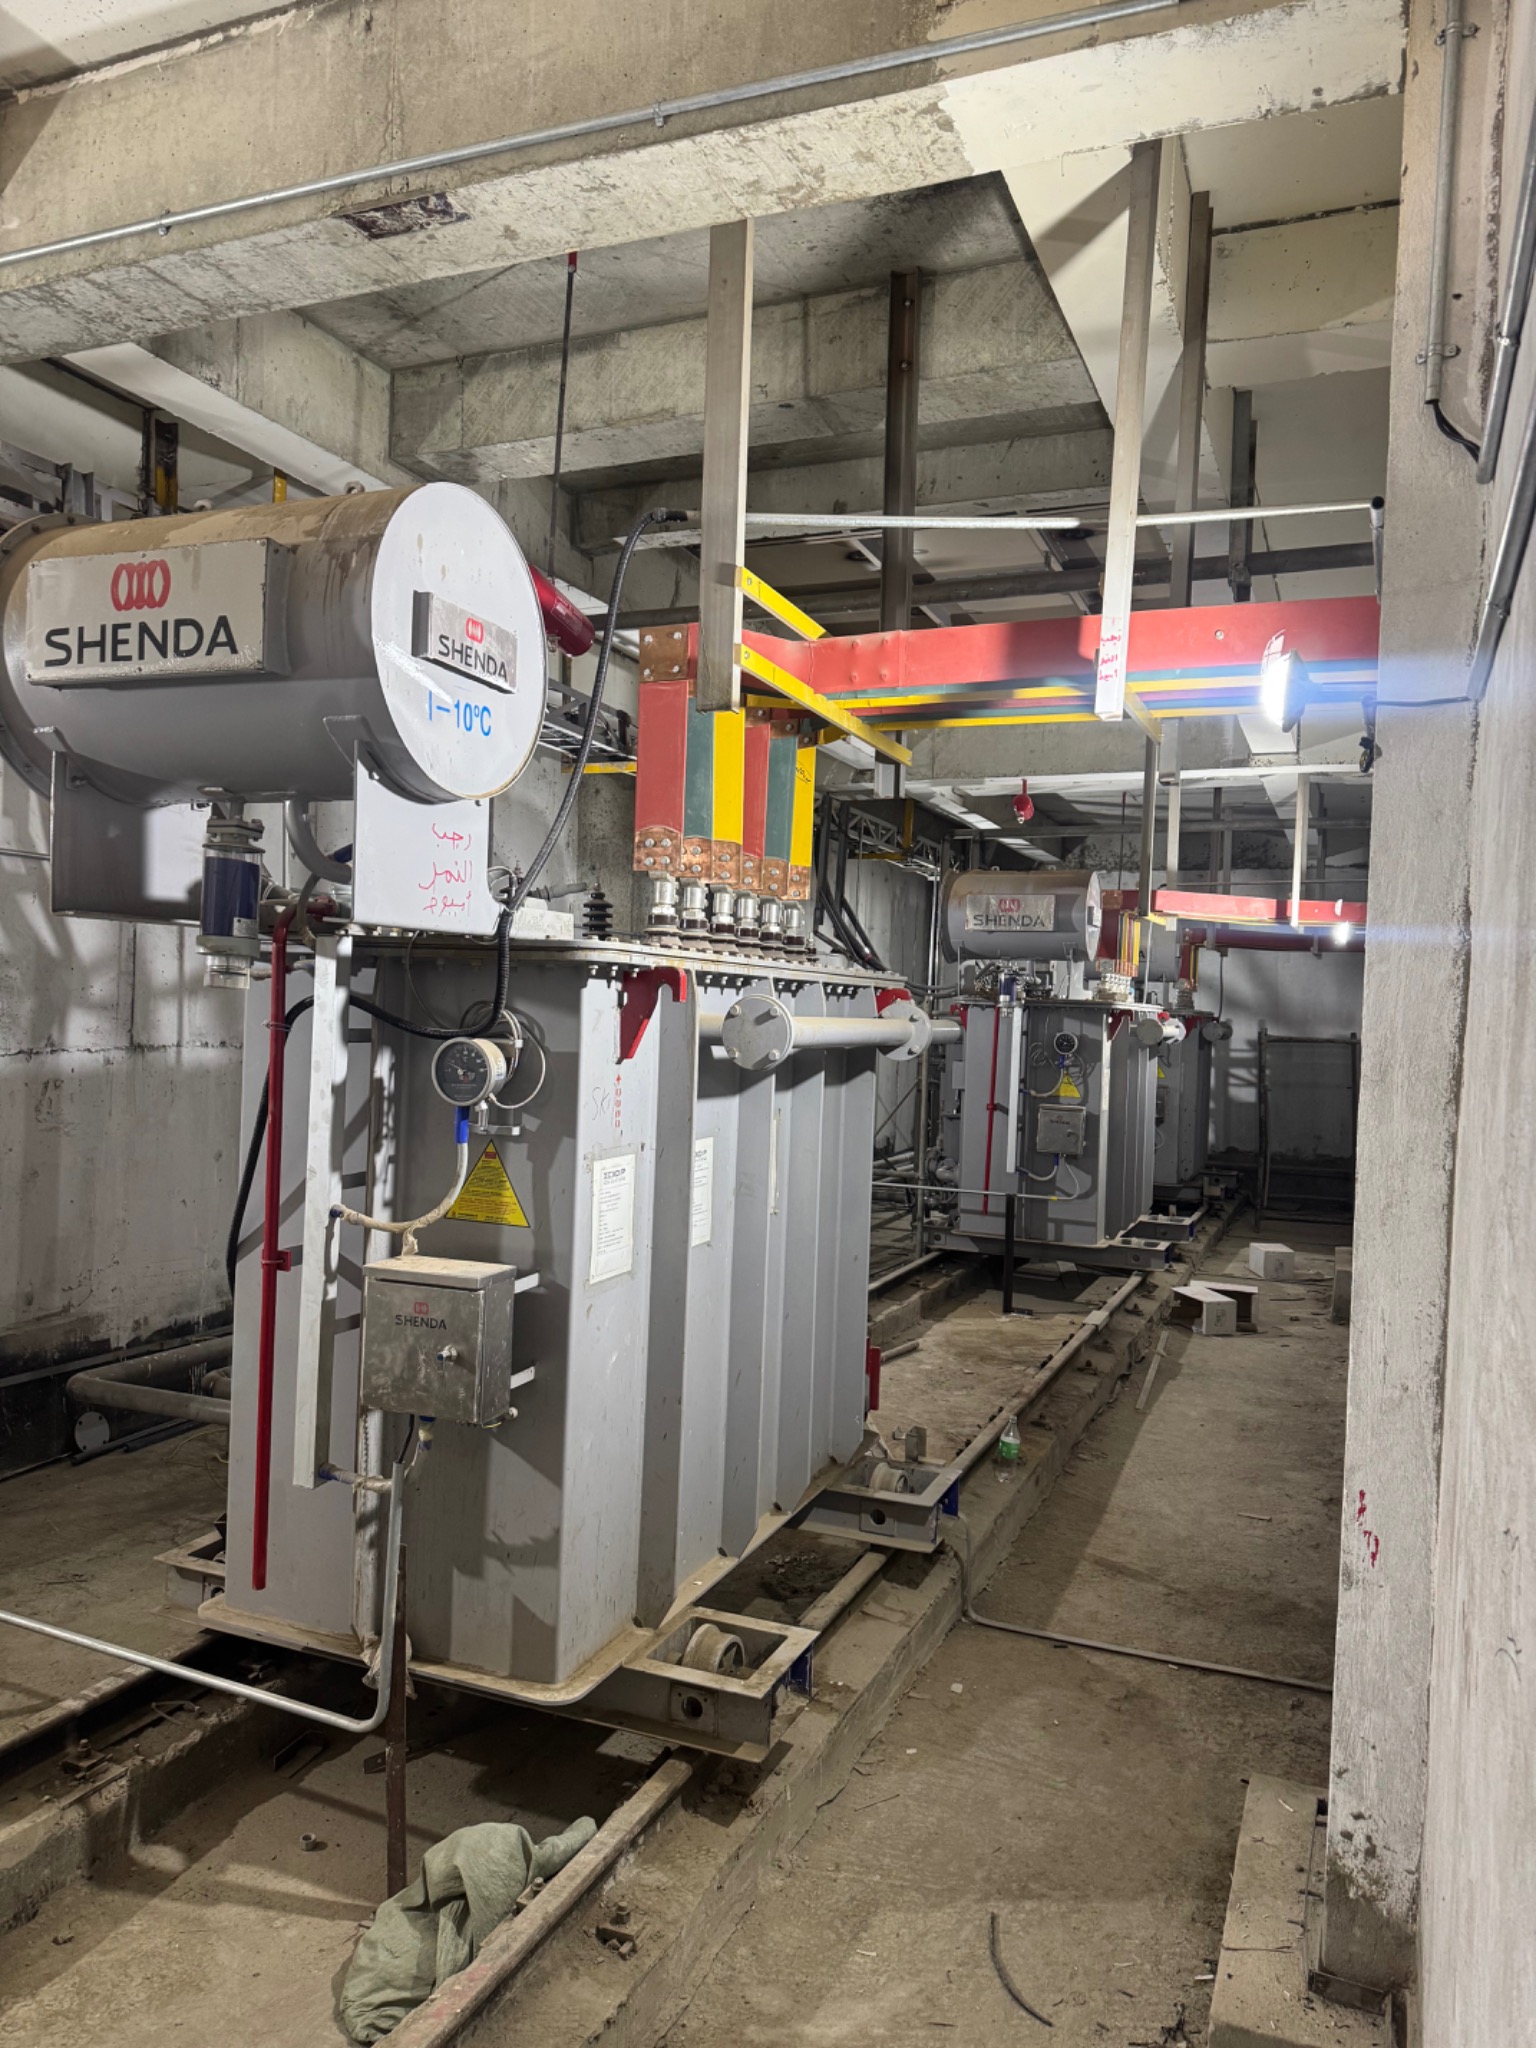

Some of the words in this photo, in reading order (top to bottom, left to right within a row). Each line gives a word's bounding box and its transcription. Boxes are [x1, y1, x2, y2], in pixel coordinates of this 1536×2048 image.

[44, 615, 239, 668] SHENDA
[438, 633, 508, 683] SHENDA
[973, 914, 1046, 928] SHENDA
[394, 1314, 447, 1330] SHENDA
